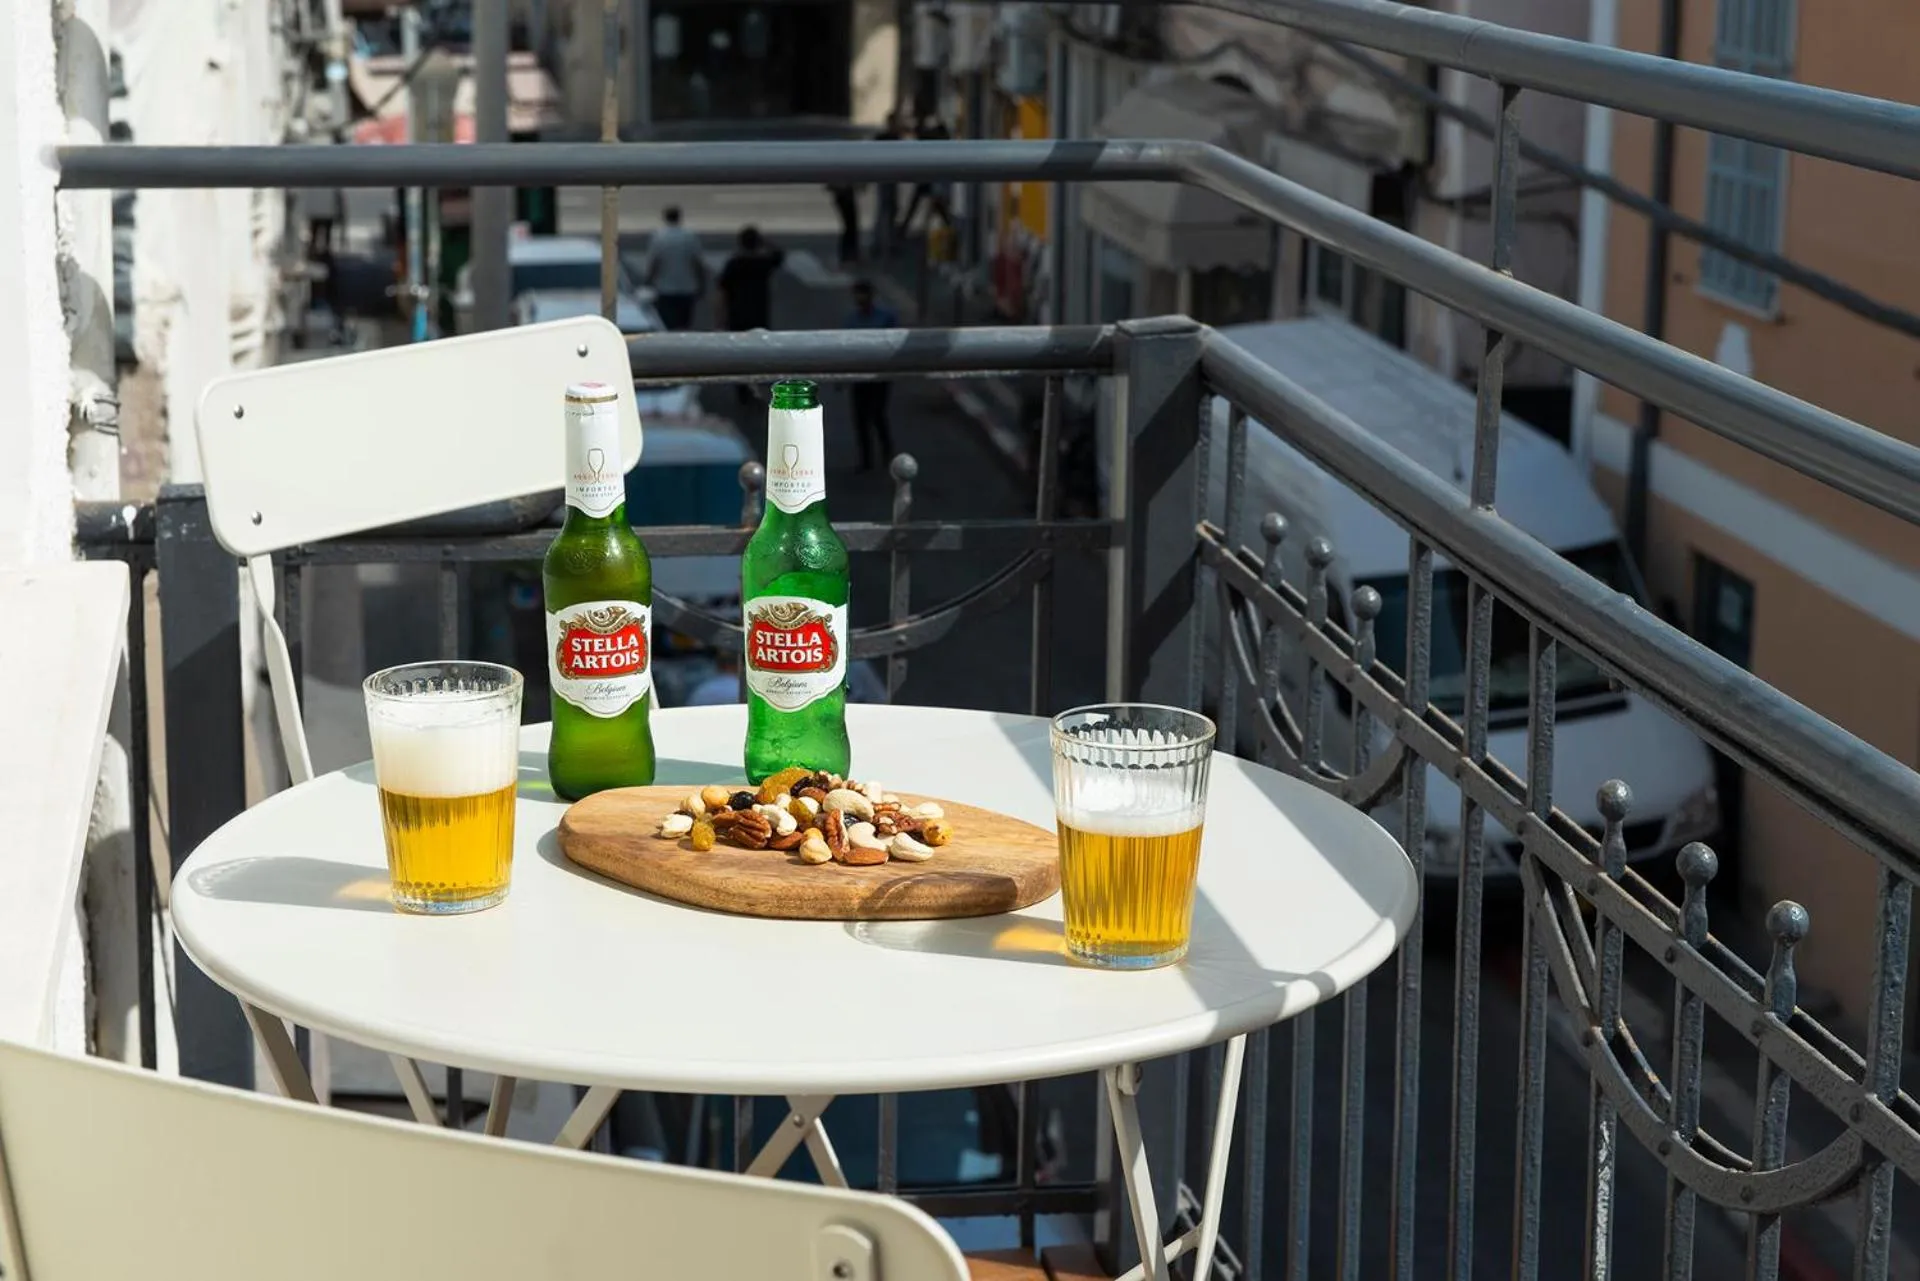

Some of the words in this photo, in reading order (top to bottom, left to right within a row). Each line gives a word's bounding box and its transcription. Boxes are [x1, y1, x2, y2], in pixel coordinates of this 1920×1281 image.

[571, 634, 639, 653] STELLA
[756, 630, 823, 647] STELLA
[571, 650, 640, 669] ARTOIS
[756, 647, 824, 664] ARTOIS
